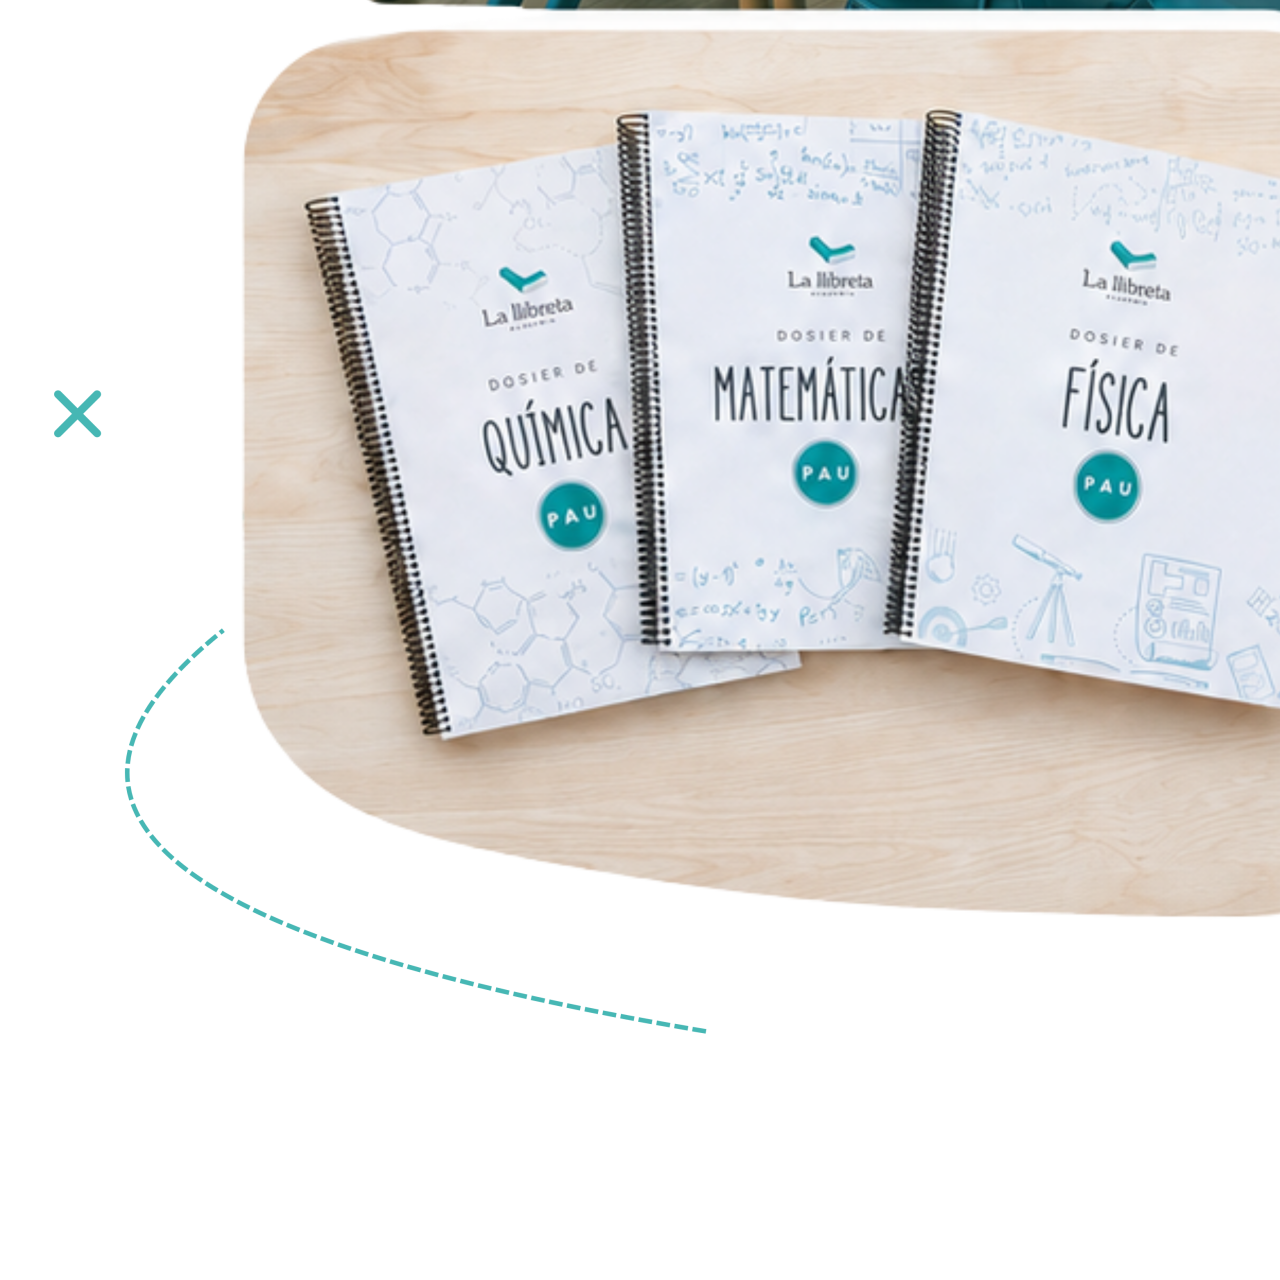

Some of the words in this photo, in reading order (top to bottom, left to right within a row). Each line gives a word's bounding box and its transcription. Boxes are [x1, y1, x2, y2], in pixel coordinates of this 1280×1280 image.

[787, 270, 811, 288] La
[816, 270, 874, 289] llibreta
[1082, 268, 1107, 290] La
[1111, 275, 1171, 302] llibreta
[481, 309, 508, 327] La
[511, 298, 574, 321] llibreta
[776, 329, 851, 342] DOSIER
[863, 329, 886, 342] DE
[1070, 328, 1144, 351] DOSIER
[1155, 342, 1179, 357] DE
[487, 366, 564, 392] DOSIER
[574, 359, 598, 375] DE
[1062, 358, 1169, 444] FÍSICA
[482, 397, 629, 477] QUÍMICA
[802, 465, 850, 481] PAU
[1084, 475, 1132, 497] PAU
[547, 504, 597, 529] PAU
